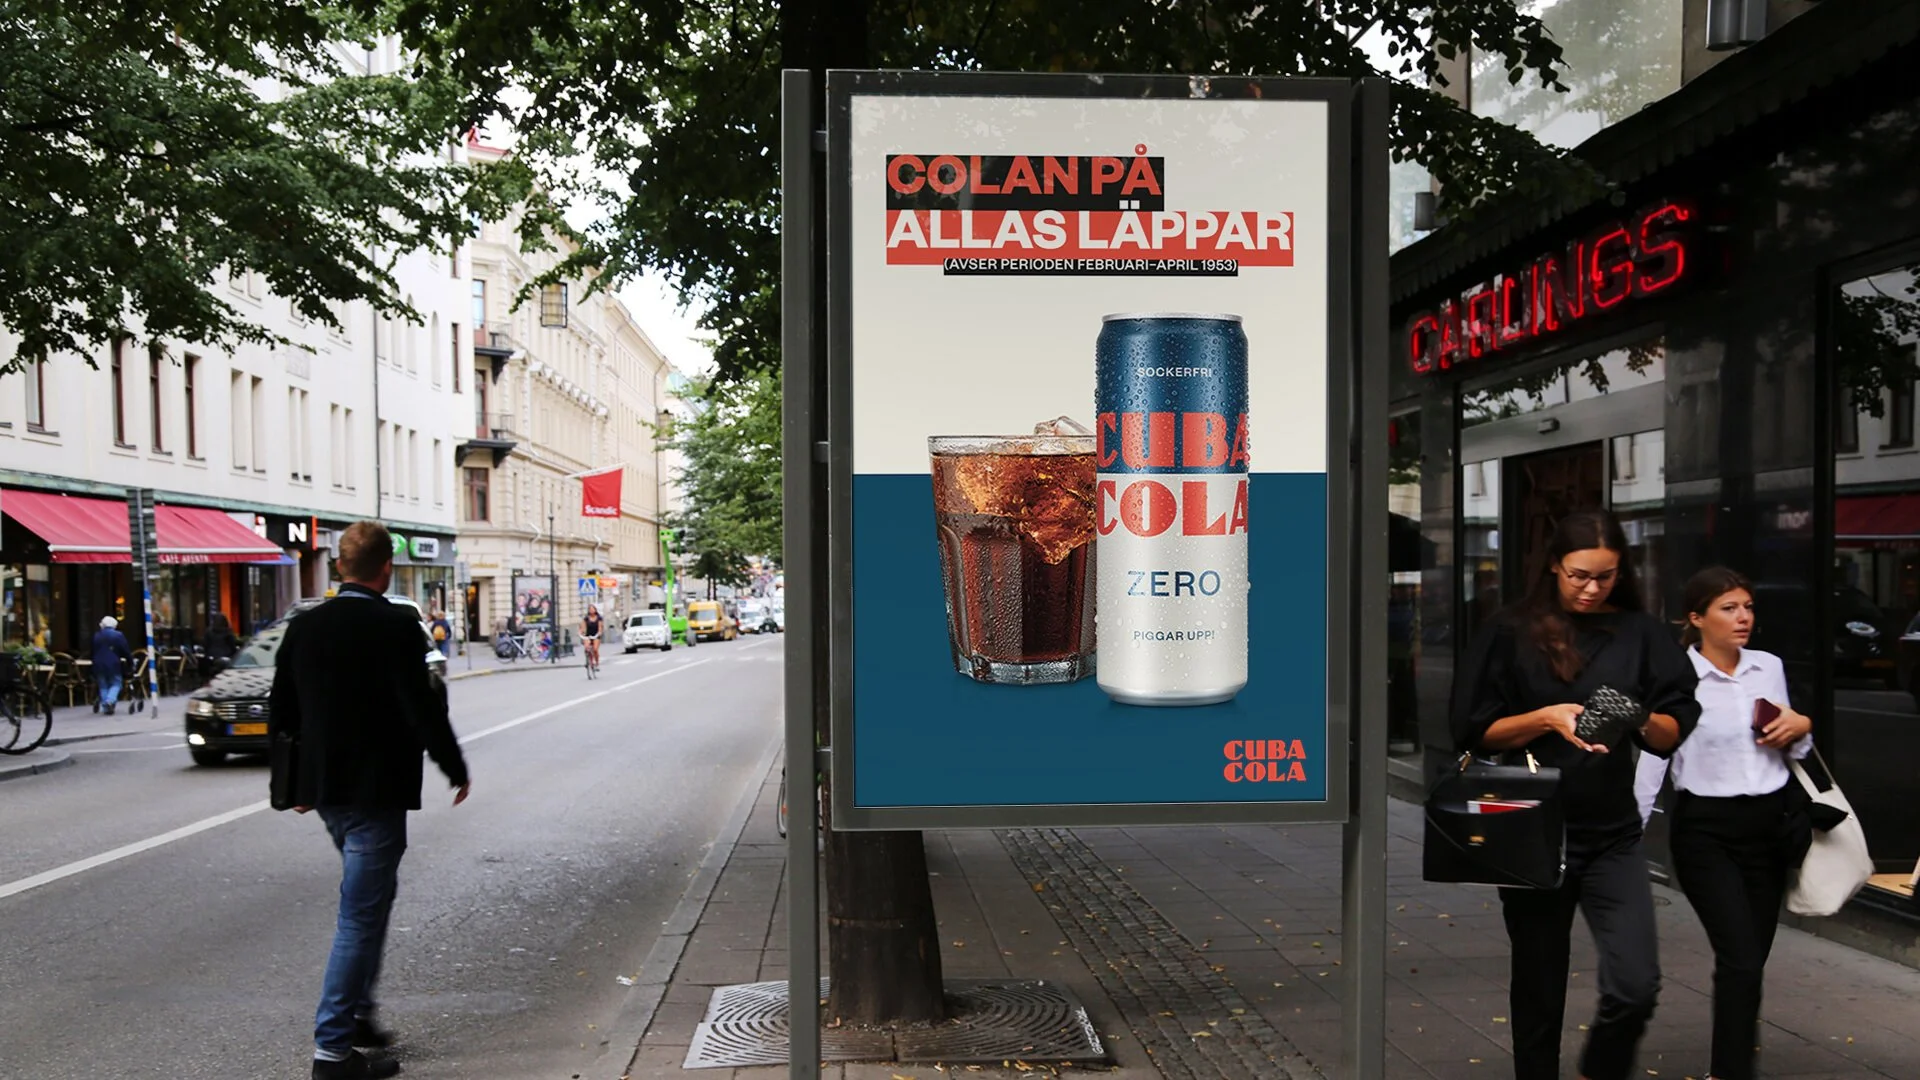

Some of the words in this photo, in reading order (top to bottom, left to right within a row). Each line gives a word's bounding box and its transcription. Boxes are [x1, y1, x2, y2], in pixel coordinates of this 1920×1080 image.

[886, 154, 1079, 195] COLAN
[1092, 143, 1162, 195] PÅ
[886, 209, 1067, 249] ALLAS
[1079, 200, 1291, 250] LÄPPAR
[944, 258, 1000, 271] (AVSER
[1001, 258, 1075, 271] PERIODEN
[1201, 258, 1238, 271] 1953)
[1410, 203, 1690, 372] CARLINGS
[1136, 367, 1212, 377] SOCKERFRI
[1097, 412, 1249, 468] CUBA
[585, 505, 617, 514] Scandic
[1097, 480, 1248, 537] COLA
[1127, 571, 1220, 597] ZERO
[1133, 631, 1184, 641] PIGGAR
[1187, 631, 1215, 641] UPP!
[1223, 739, 1306, 760] CUBA
[1223, 761, 1306, 783] COLA
